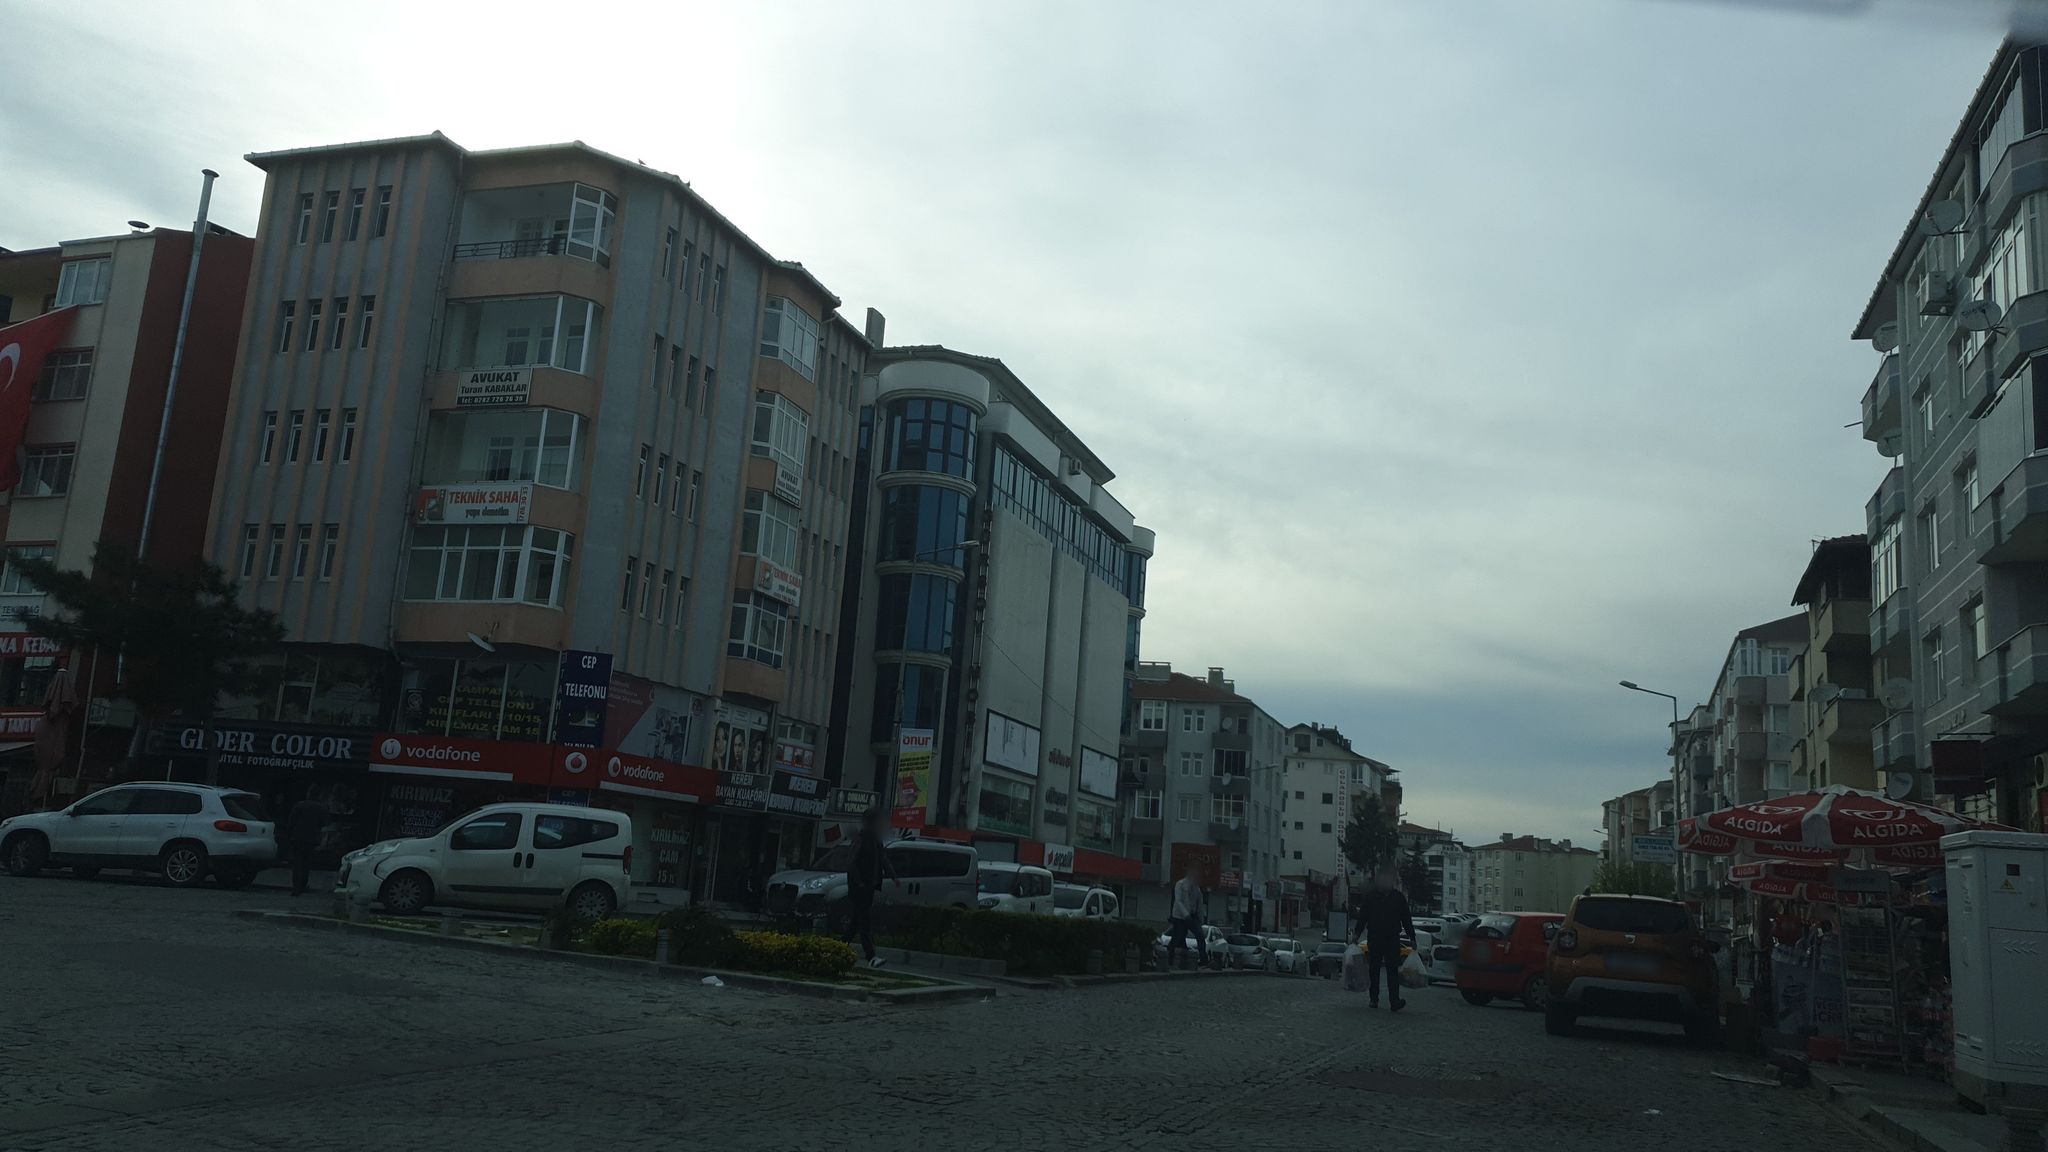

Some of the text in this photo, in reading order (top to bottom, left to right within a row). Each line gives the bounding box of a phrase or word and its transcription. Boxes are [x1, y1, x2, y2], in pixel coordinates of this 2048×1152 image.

[470, 371, 520, 383] AVUKAT
[461, 384, 527, 395] Turan KABAKLAR
[448, 490, 519, 504] TEKNİK SAHA
[581, 656, 597, 669] CEP
[565, 682, 607, 699] TELEFONU
[467, 698, 535, 711] TELEONU
[270, 733, 352, 759] COLOR
[406, 745, 481, 762] vodafone
[623, 764, 664, 783] vodafone
[715, 784, 736, 799] BAYAN
[1724, 816, 1783, 835] ALGIDA
[1852, 824, 1922, 839] ALGIDA
